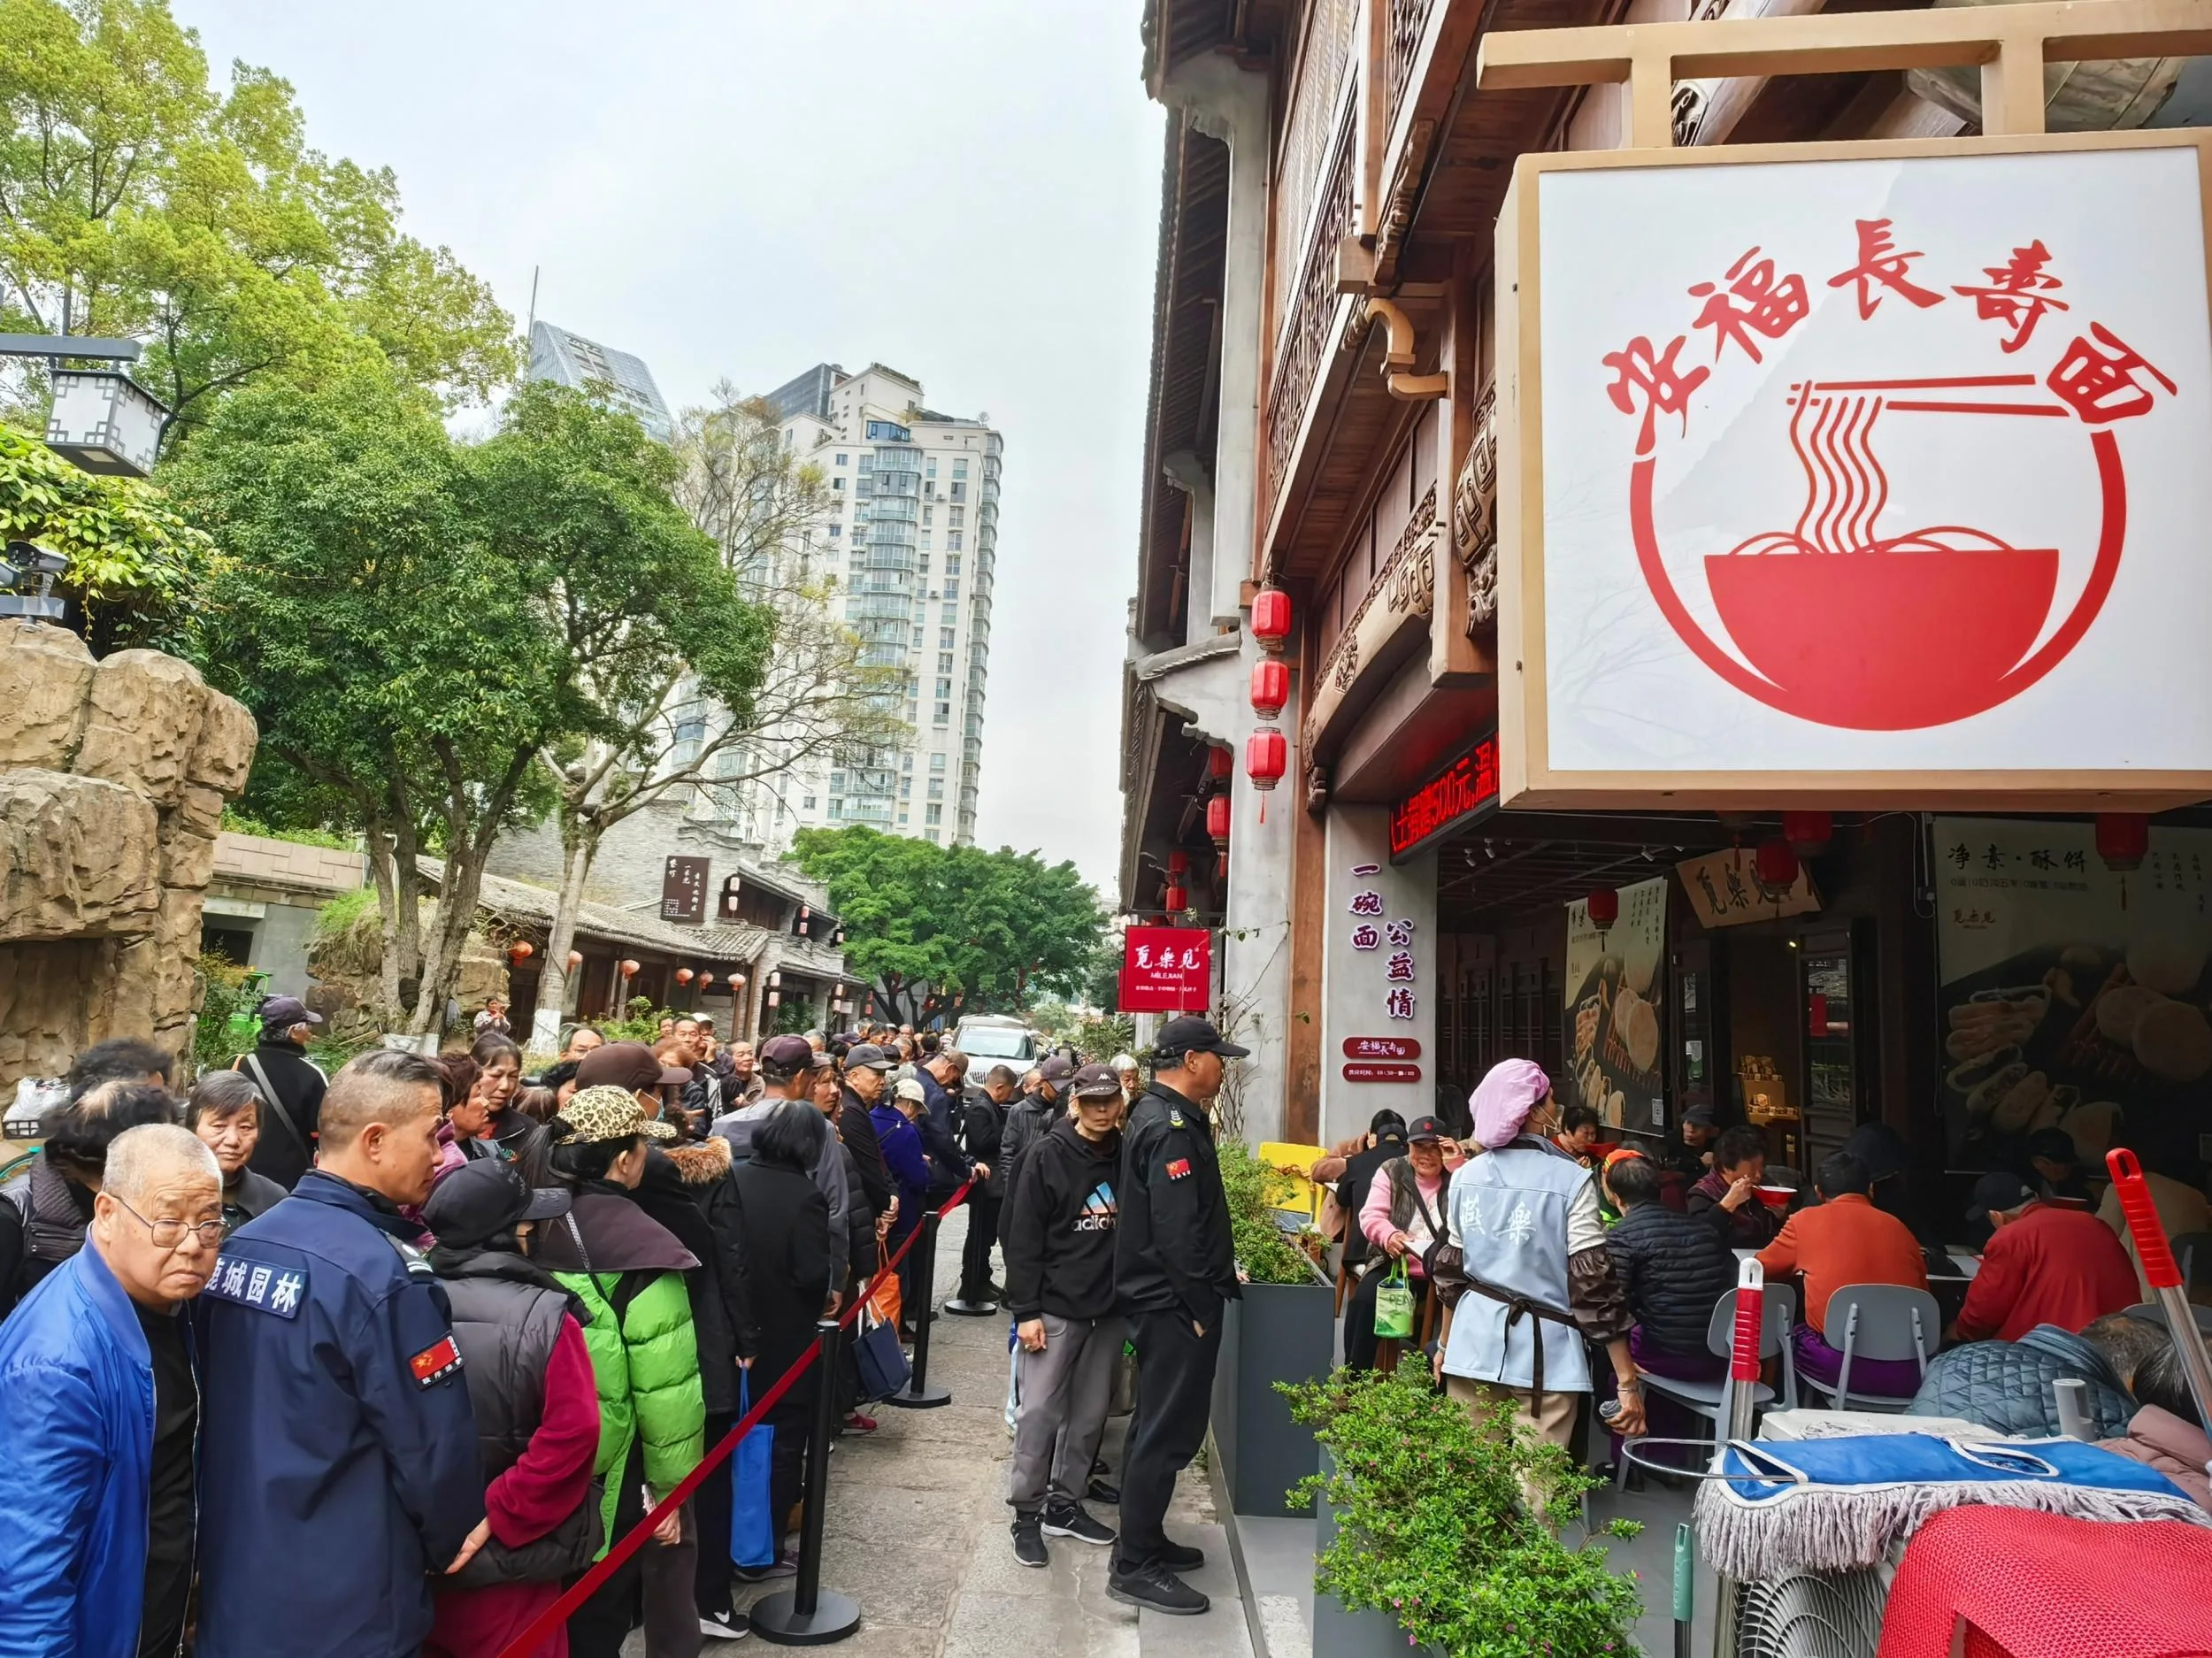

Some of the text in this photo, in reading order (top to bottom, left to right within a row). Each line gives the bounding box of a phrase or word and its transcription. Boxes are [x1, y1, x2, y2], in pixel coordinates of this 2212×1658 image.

[1350, 864, 1382, 949] 一碗面
[1386, 919, 1415, 1019] 公益情
[1072, 1215, 1118, 1232] adid
